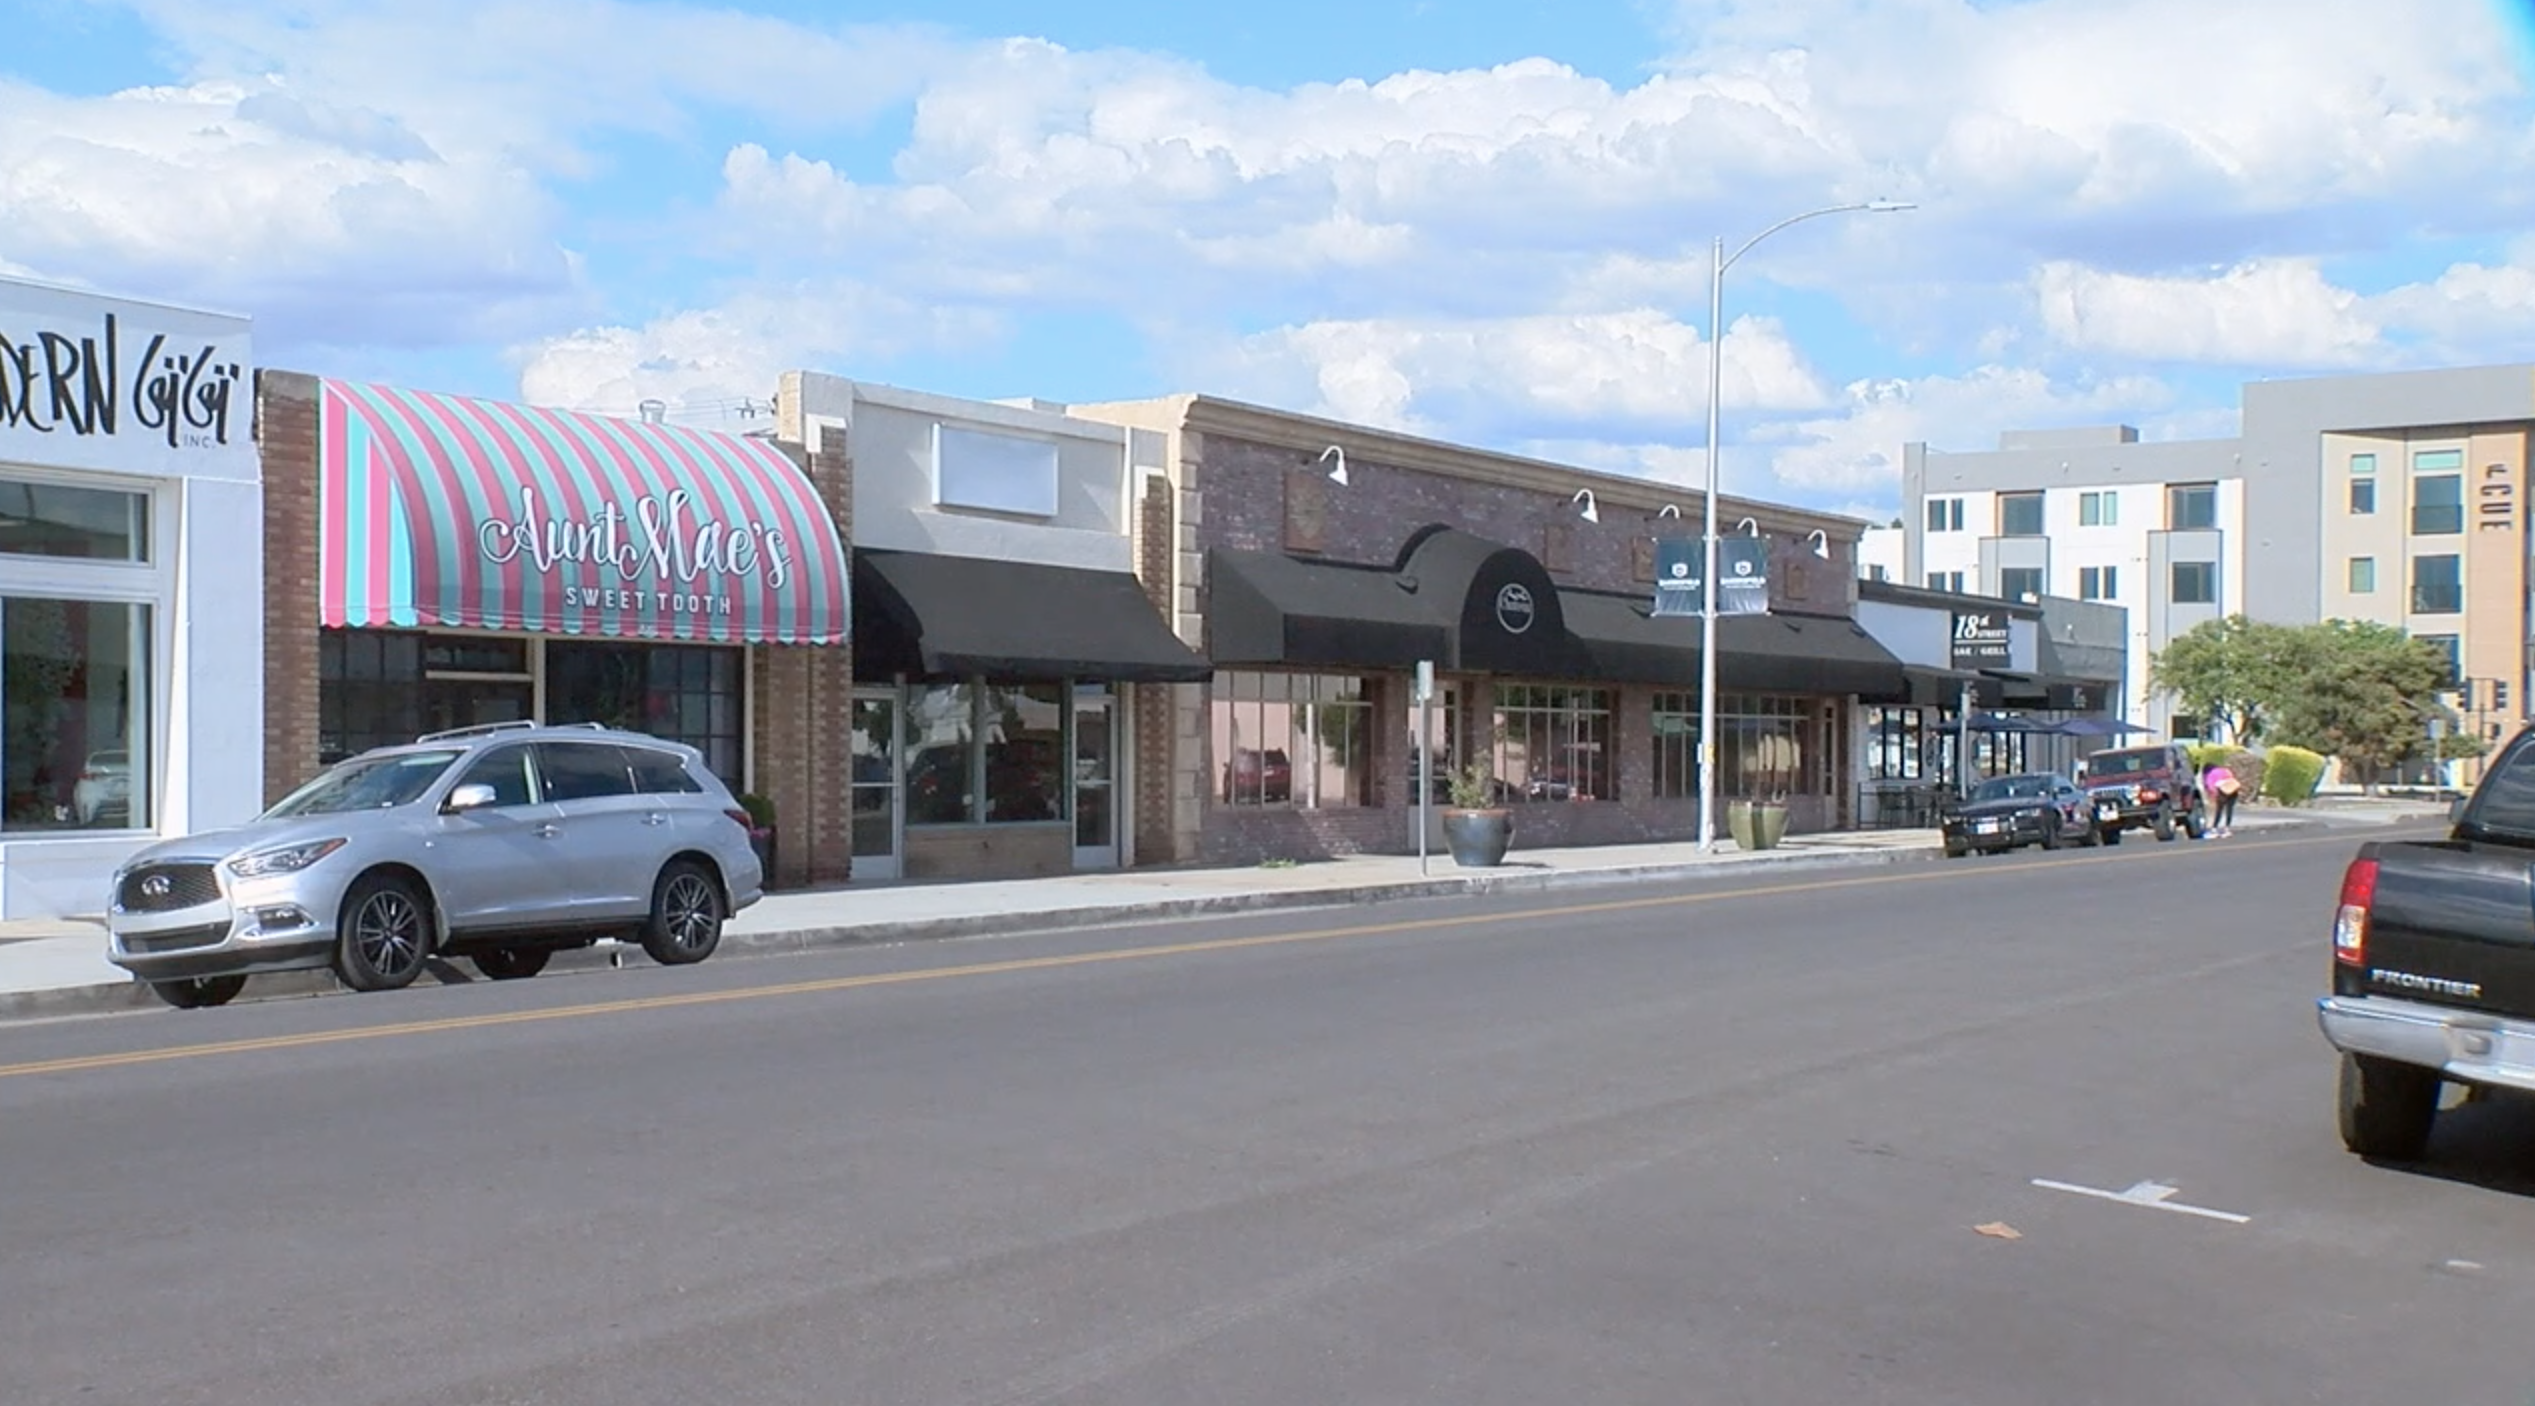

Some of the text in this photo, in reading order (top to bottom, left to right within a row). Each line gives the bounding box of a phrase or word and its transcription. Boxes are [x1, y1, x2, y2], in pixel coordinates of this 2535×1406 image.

[2480, 484, 2513, 531] CUE
[480, 487, 794, 589] Aunt Mae's
[565, 586, 732, 615] SWEET TOOTH
[2371, 968, 2482, 998] FRONTIER
